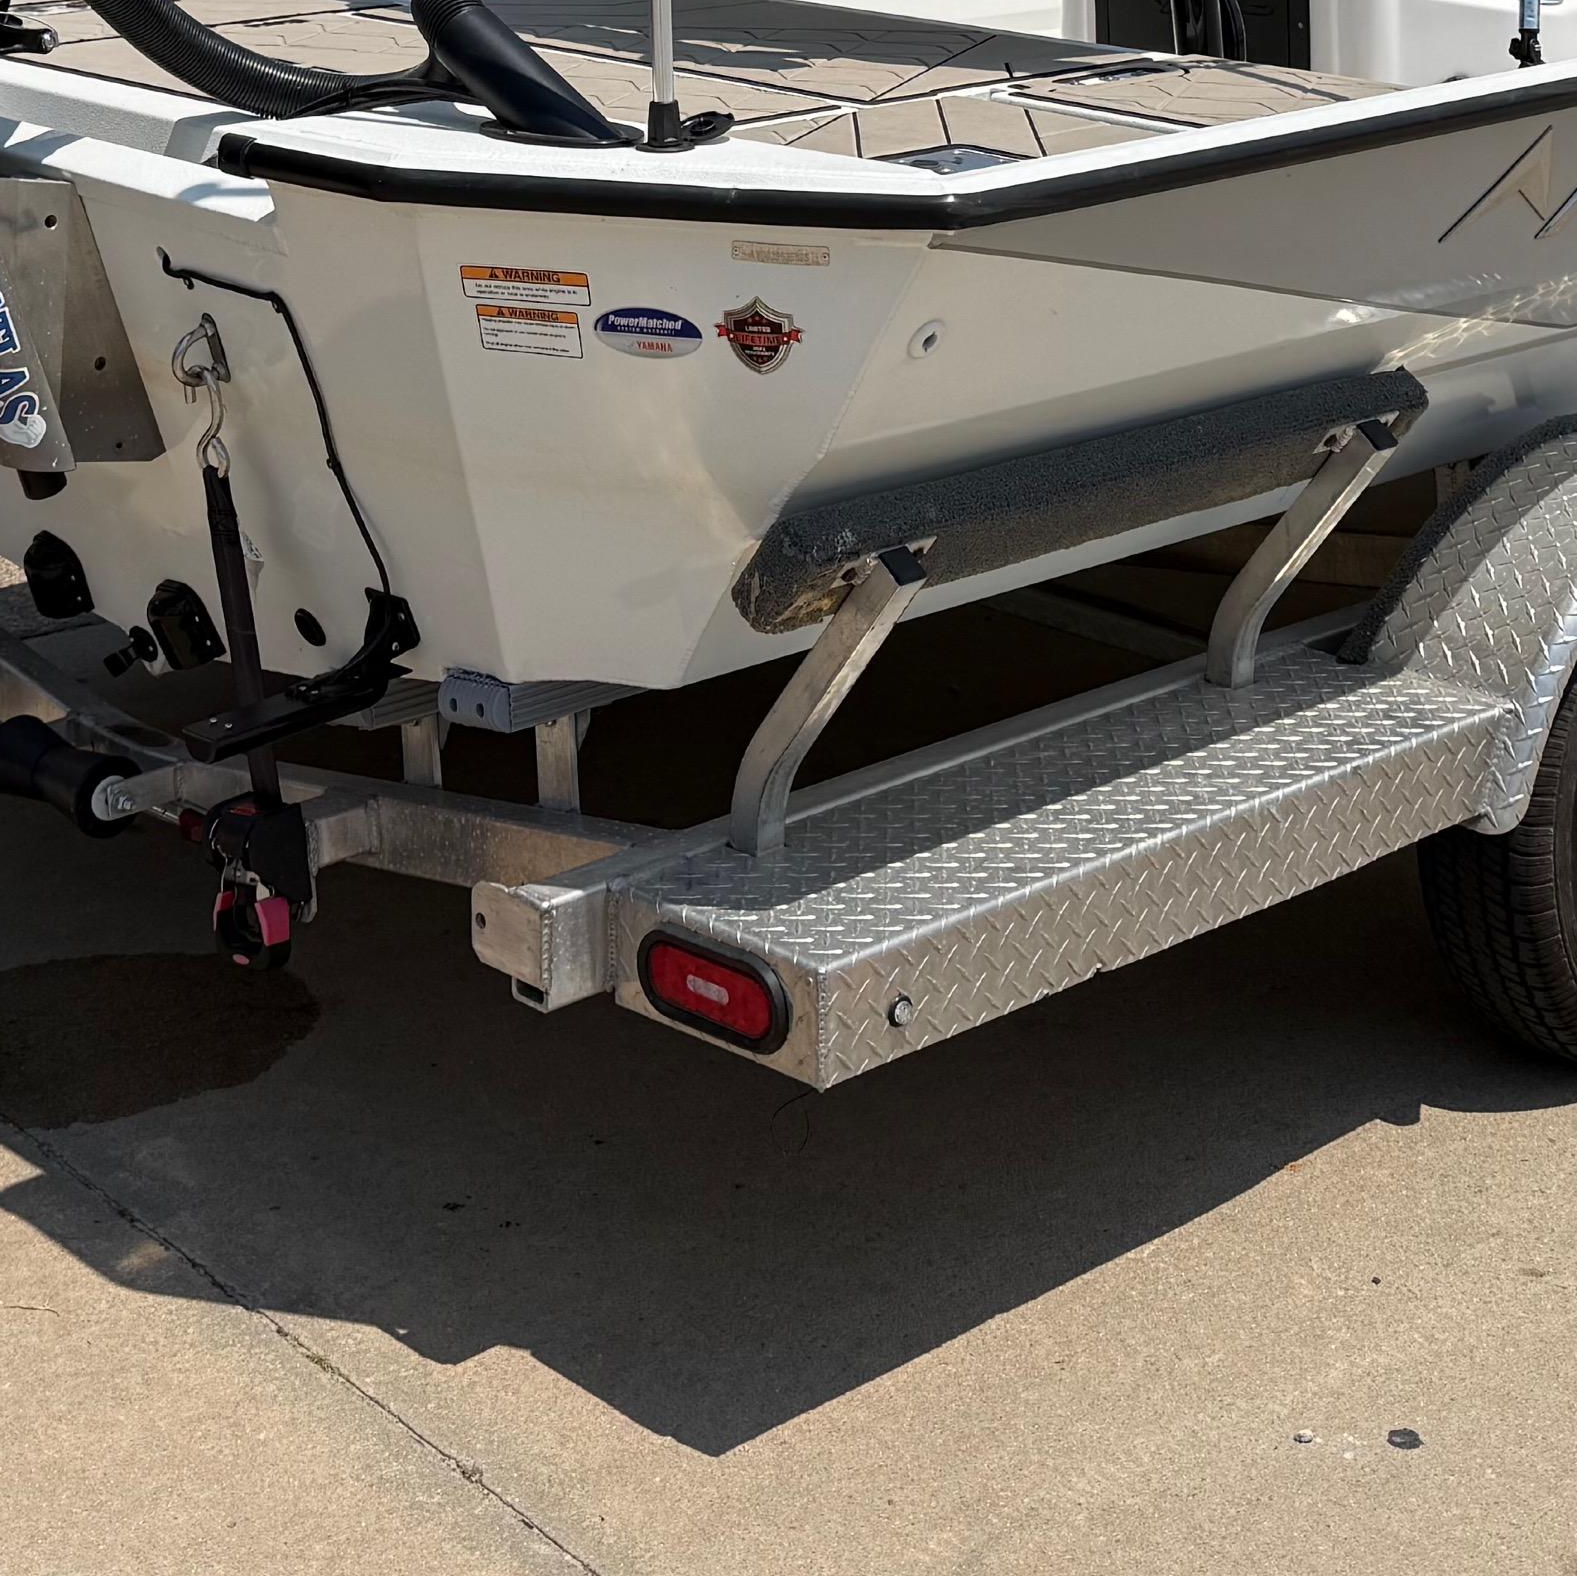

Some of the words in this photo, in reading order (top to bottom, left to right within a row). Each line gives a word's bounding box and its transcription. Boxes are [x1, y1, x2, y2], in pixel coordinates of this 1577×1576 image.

[502, 269, 561, 283] WARNING
[508, 308, 560, 321] WARNING
[608, 314, 683, 330] PowerMatched
[636, 340, 673, 353] YAMAHA
